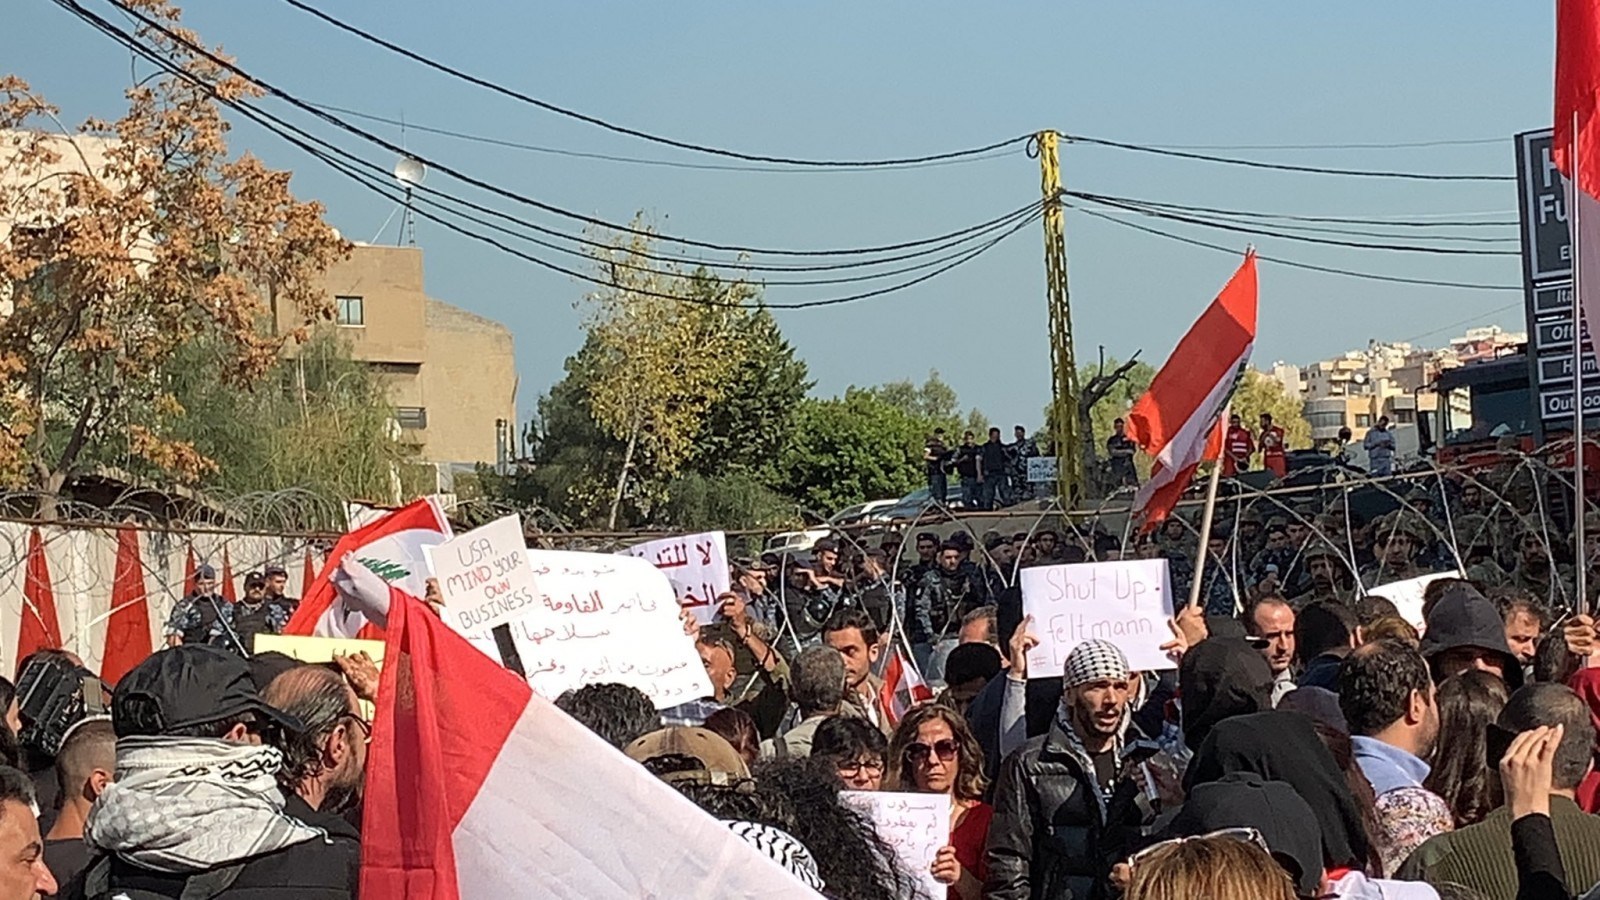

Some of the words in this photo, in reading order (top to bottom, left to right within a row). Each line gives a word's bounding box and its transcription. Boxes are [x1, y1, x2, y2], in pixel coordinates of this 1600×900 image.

[1549, 395, 1600, 411] Outoo
[447, 565, 492, 596] MIND
[493, 551, 523, 577] YOUR
[484, 578, 511, 599] OWN
[1047, 568, 1096, 601] Shut
[458, 586, 533, 629] BUSINESS
